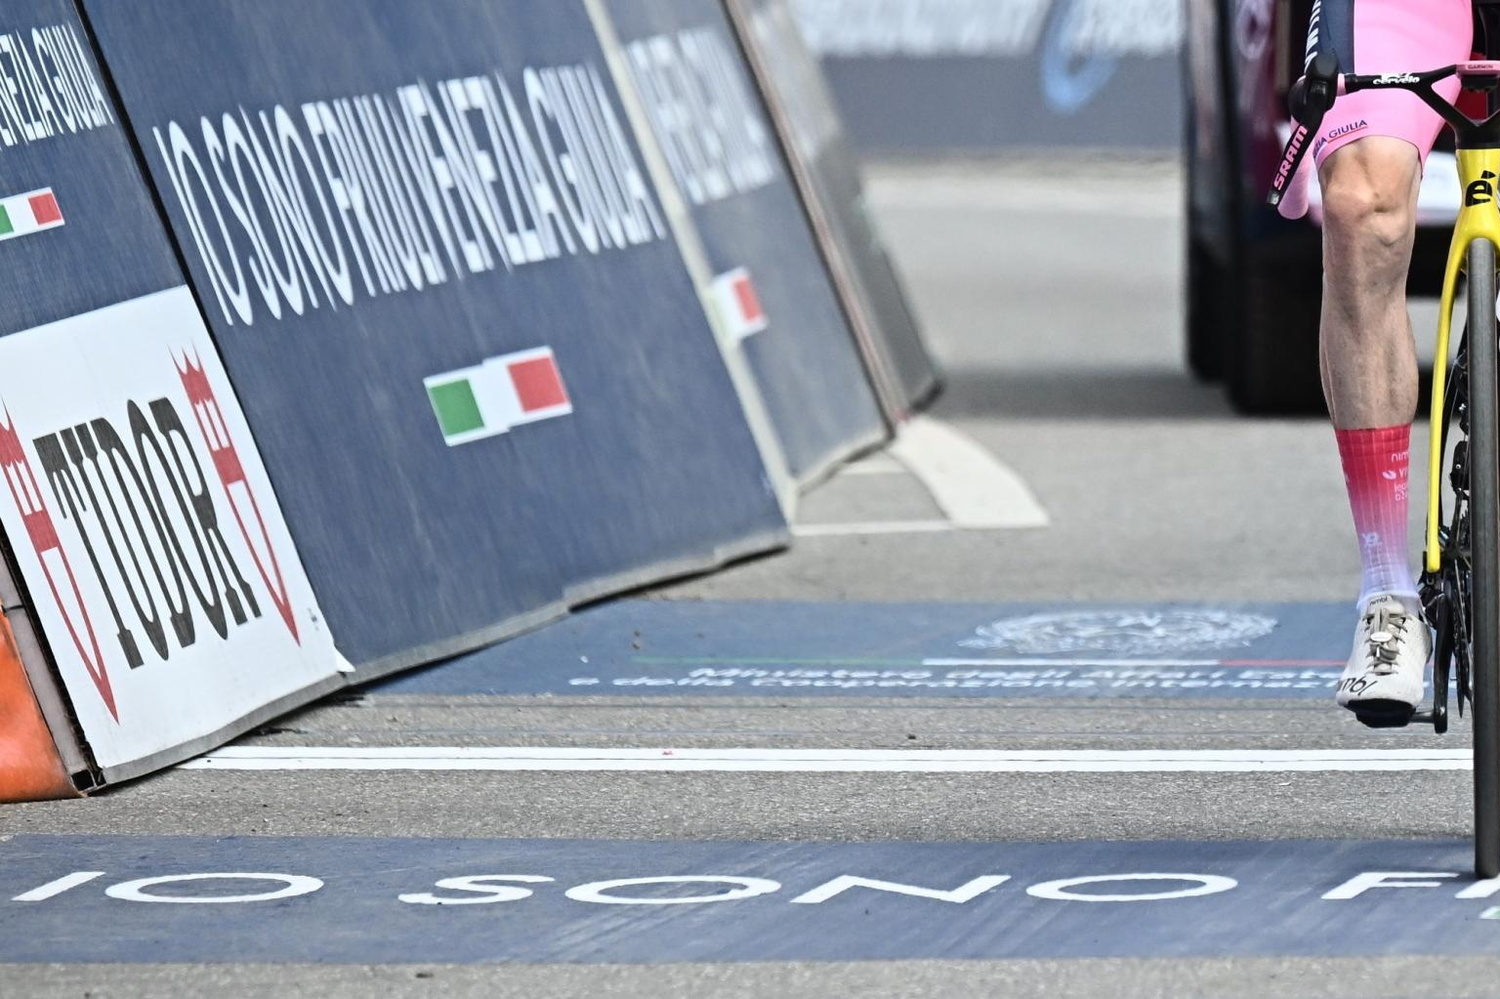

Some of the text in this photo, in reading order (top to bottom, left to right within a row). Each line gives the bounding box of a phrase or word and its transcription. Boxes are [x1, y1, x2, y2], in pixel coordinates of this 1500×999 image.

[31, 21, 114, 134] GIULIA
[387, 69, 577, 281] VENEZIA
[523, 61, 666, 255] GIULIA
[1273, 124, 1307, 191] SRAM
[1328, 119, 1368, 139] GIULIA
[152, 120, 253, 326] IO
[200, 104, 353, 320] SONO
[302, 92, 447, 297] FRIULI
[33, 398, 262, 669] TUDOR
[12, 871, 325, 904] IO
[398, 871, 1240, 906] SONO
